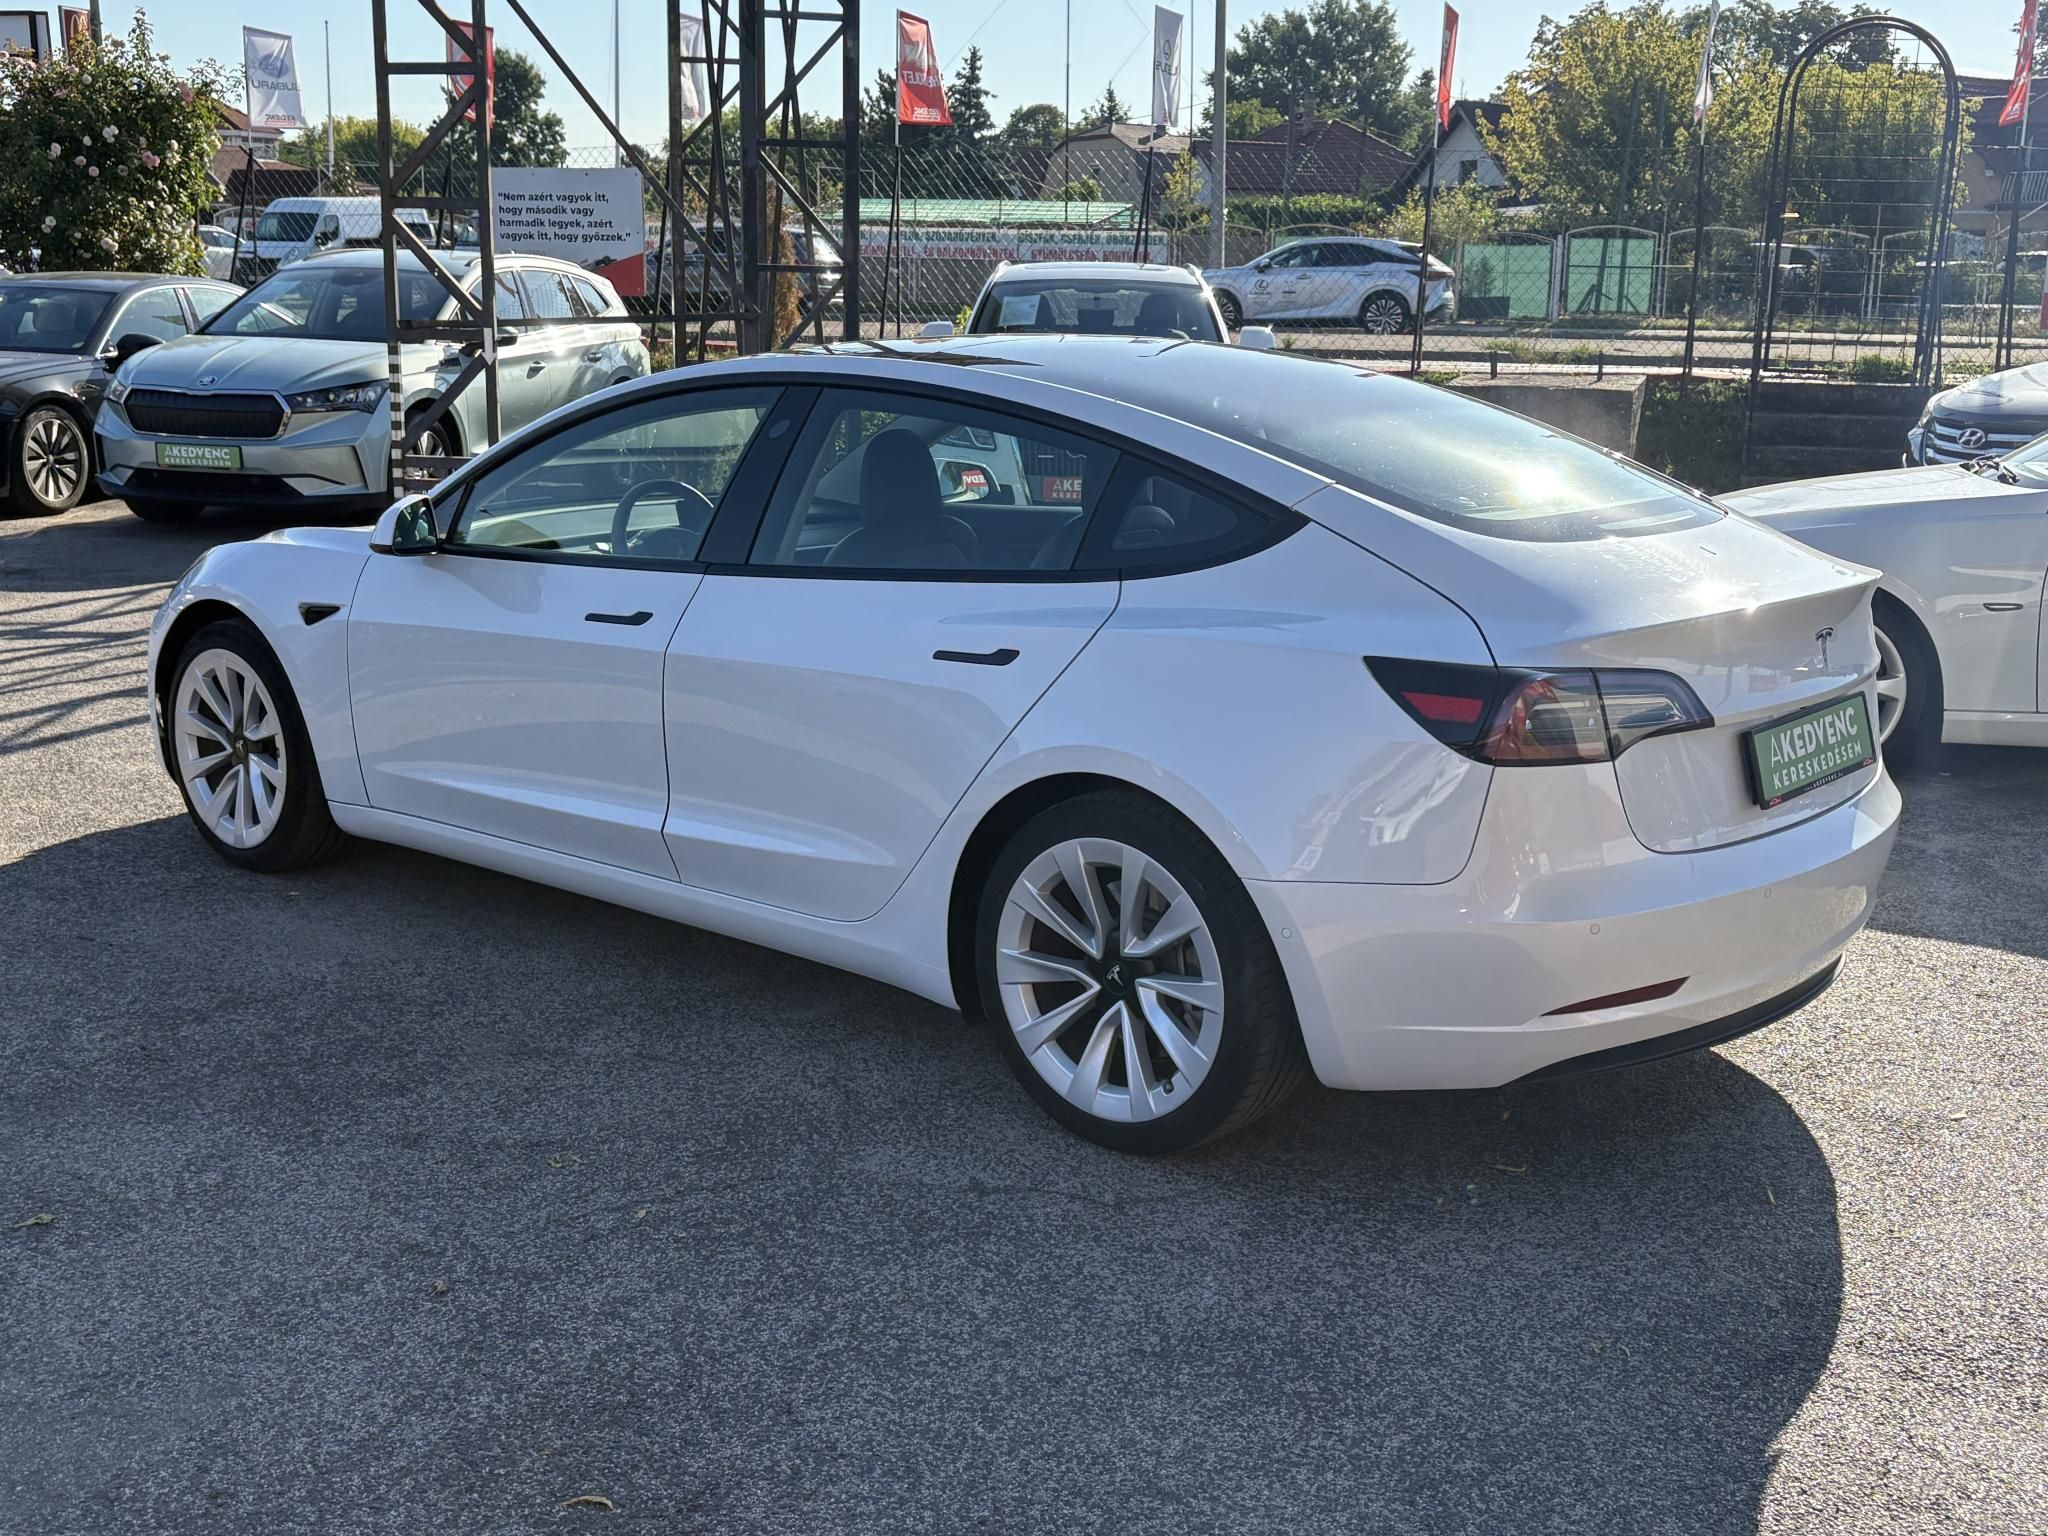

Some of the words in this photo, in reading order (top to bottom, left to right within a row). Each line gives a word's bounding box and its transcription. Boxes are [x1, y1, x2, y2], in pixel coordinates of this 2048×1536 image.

[528, 193, 553, 201] azért
[556, 193, 592, 203] vagyok
[594, 193, 609, 203] itt,
[499, 205, 523, 216] hogy
[525, 206, 568, 215] második
[570, 207, 595, 217] vagy
[499, 218, 546, 227] harmadik
[548, 218, 585, 229] legyek,
[587, 219, 613, 228] azért
[500, 231, 535, 242] vagyok
[537, 231, 552, 242] itt,
[553, 232, 578, 243] hogy
[1771, 706, 1858, 768] AKEDVENC
[1773, 740, 1862, 790] KERESKEDÉSEM
